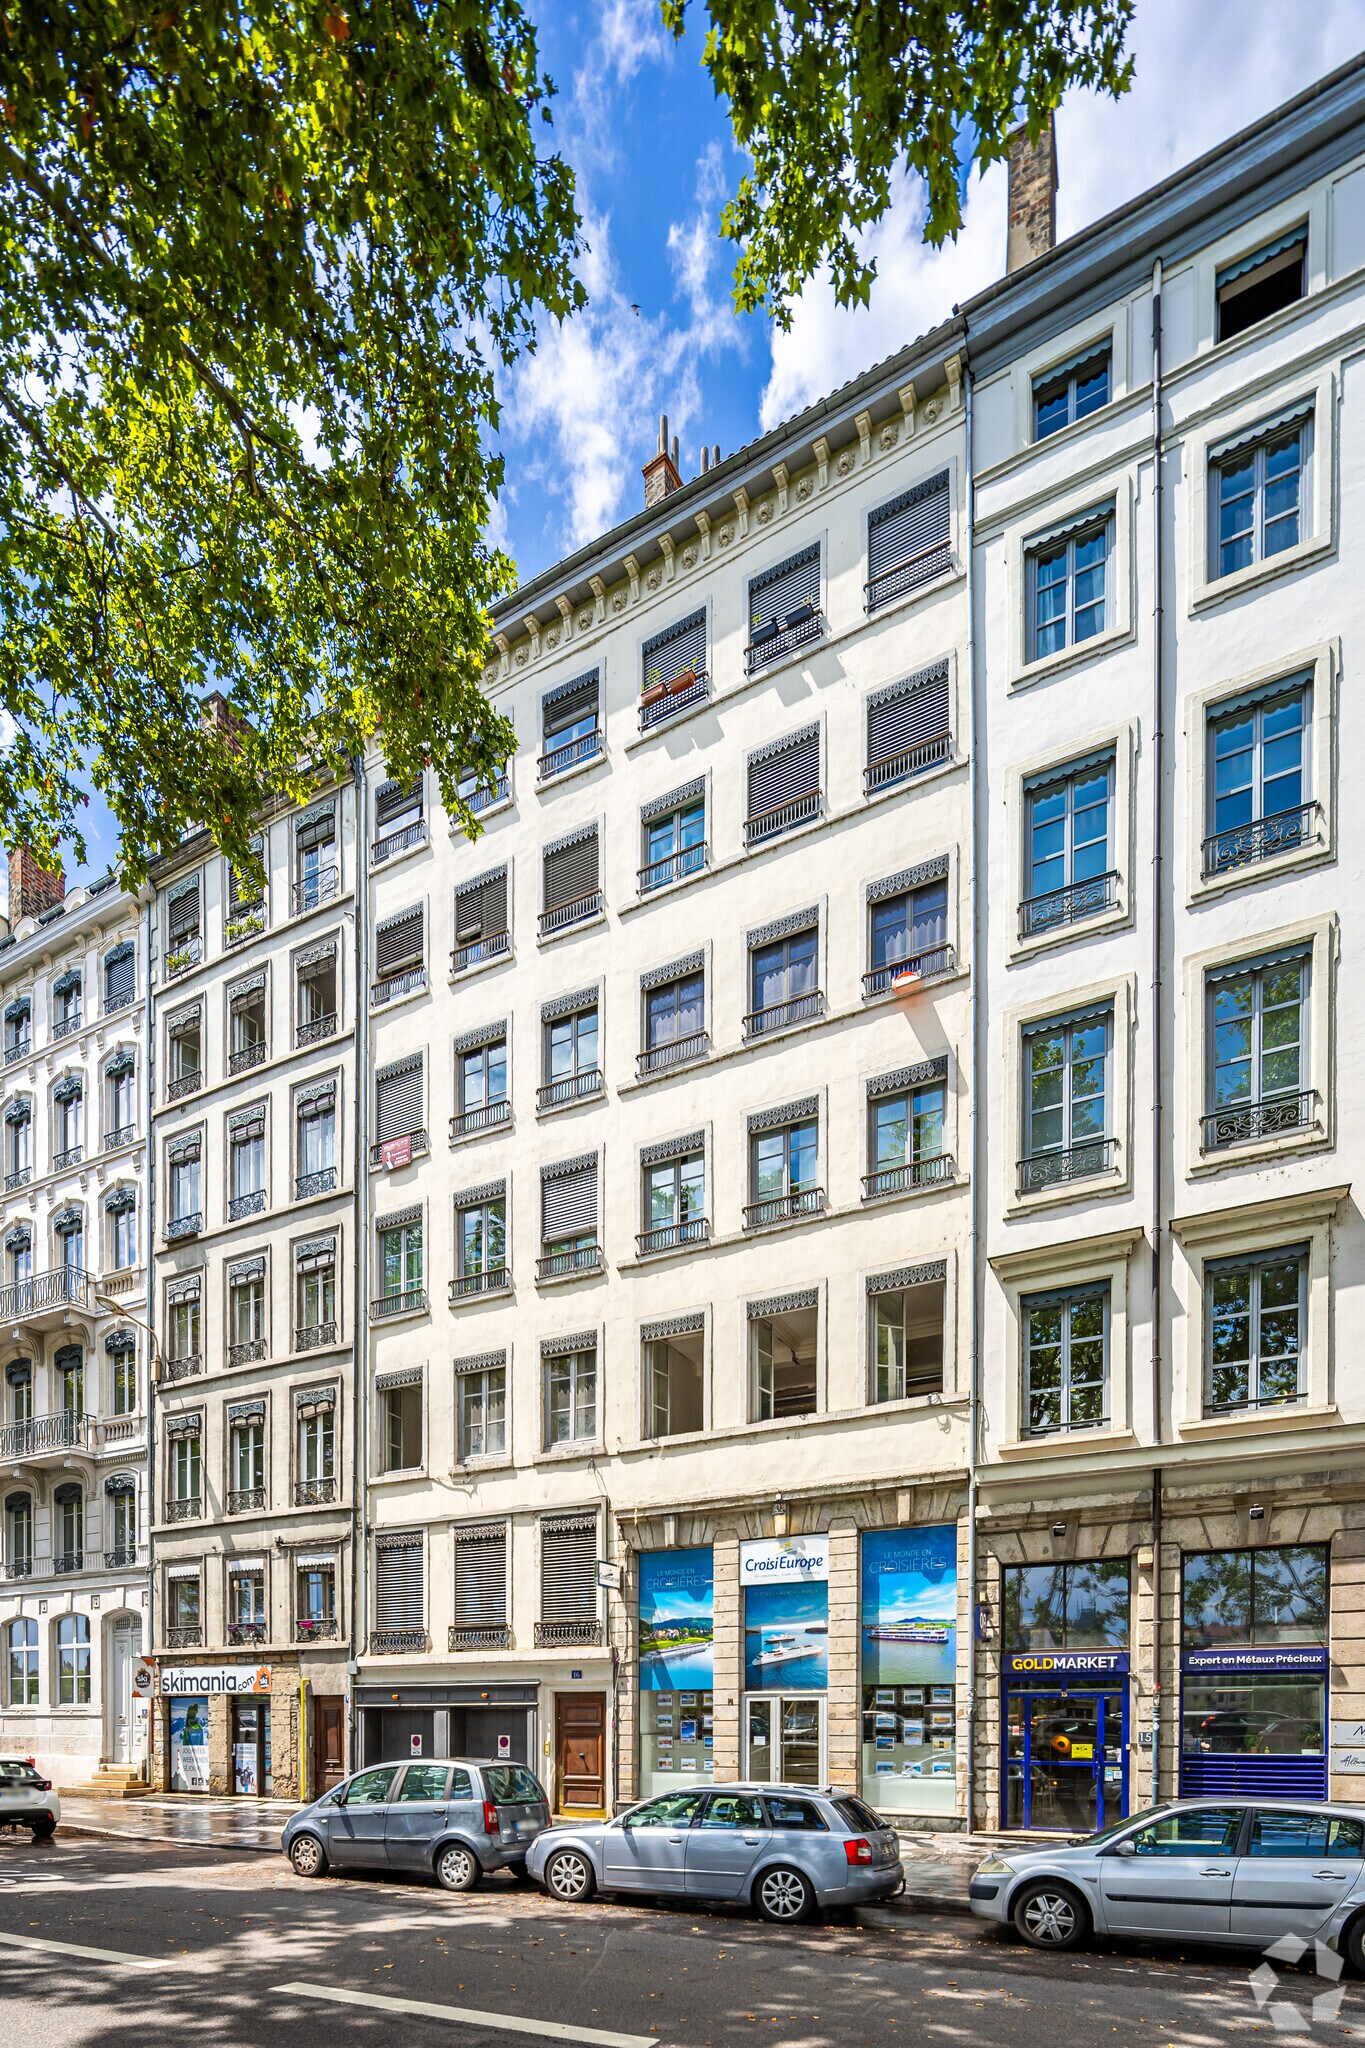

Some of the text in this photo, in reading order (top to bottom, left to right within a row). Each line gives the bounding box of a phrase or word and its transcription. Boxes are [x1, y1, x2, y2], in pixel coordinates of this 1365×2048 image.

[884, 1551, 893, 1559] LE
[893, 1550, 919, 1558] MONDE
[745, 1556, 824, 1572] CroisiEurope
[869, 1556, 947, 1574] CROISIÈRES
[645, 1575, 707, 1590] CROISIÈRES
[1012, 1656, 1118, 1671] GOLDMARKET
[1188, 1656, 1221, 1666] Expert
[1236, 1655, 1275, 1664] Métaux
[1276, 1654, 1322, 1664] Précieux
[1139, 1732, 1152, 1742] 15
